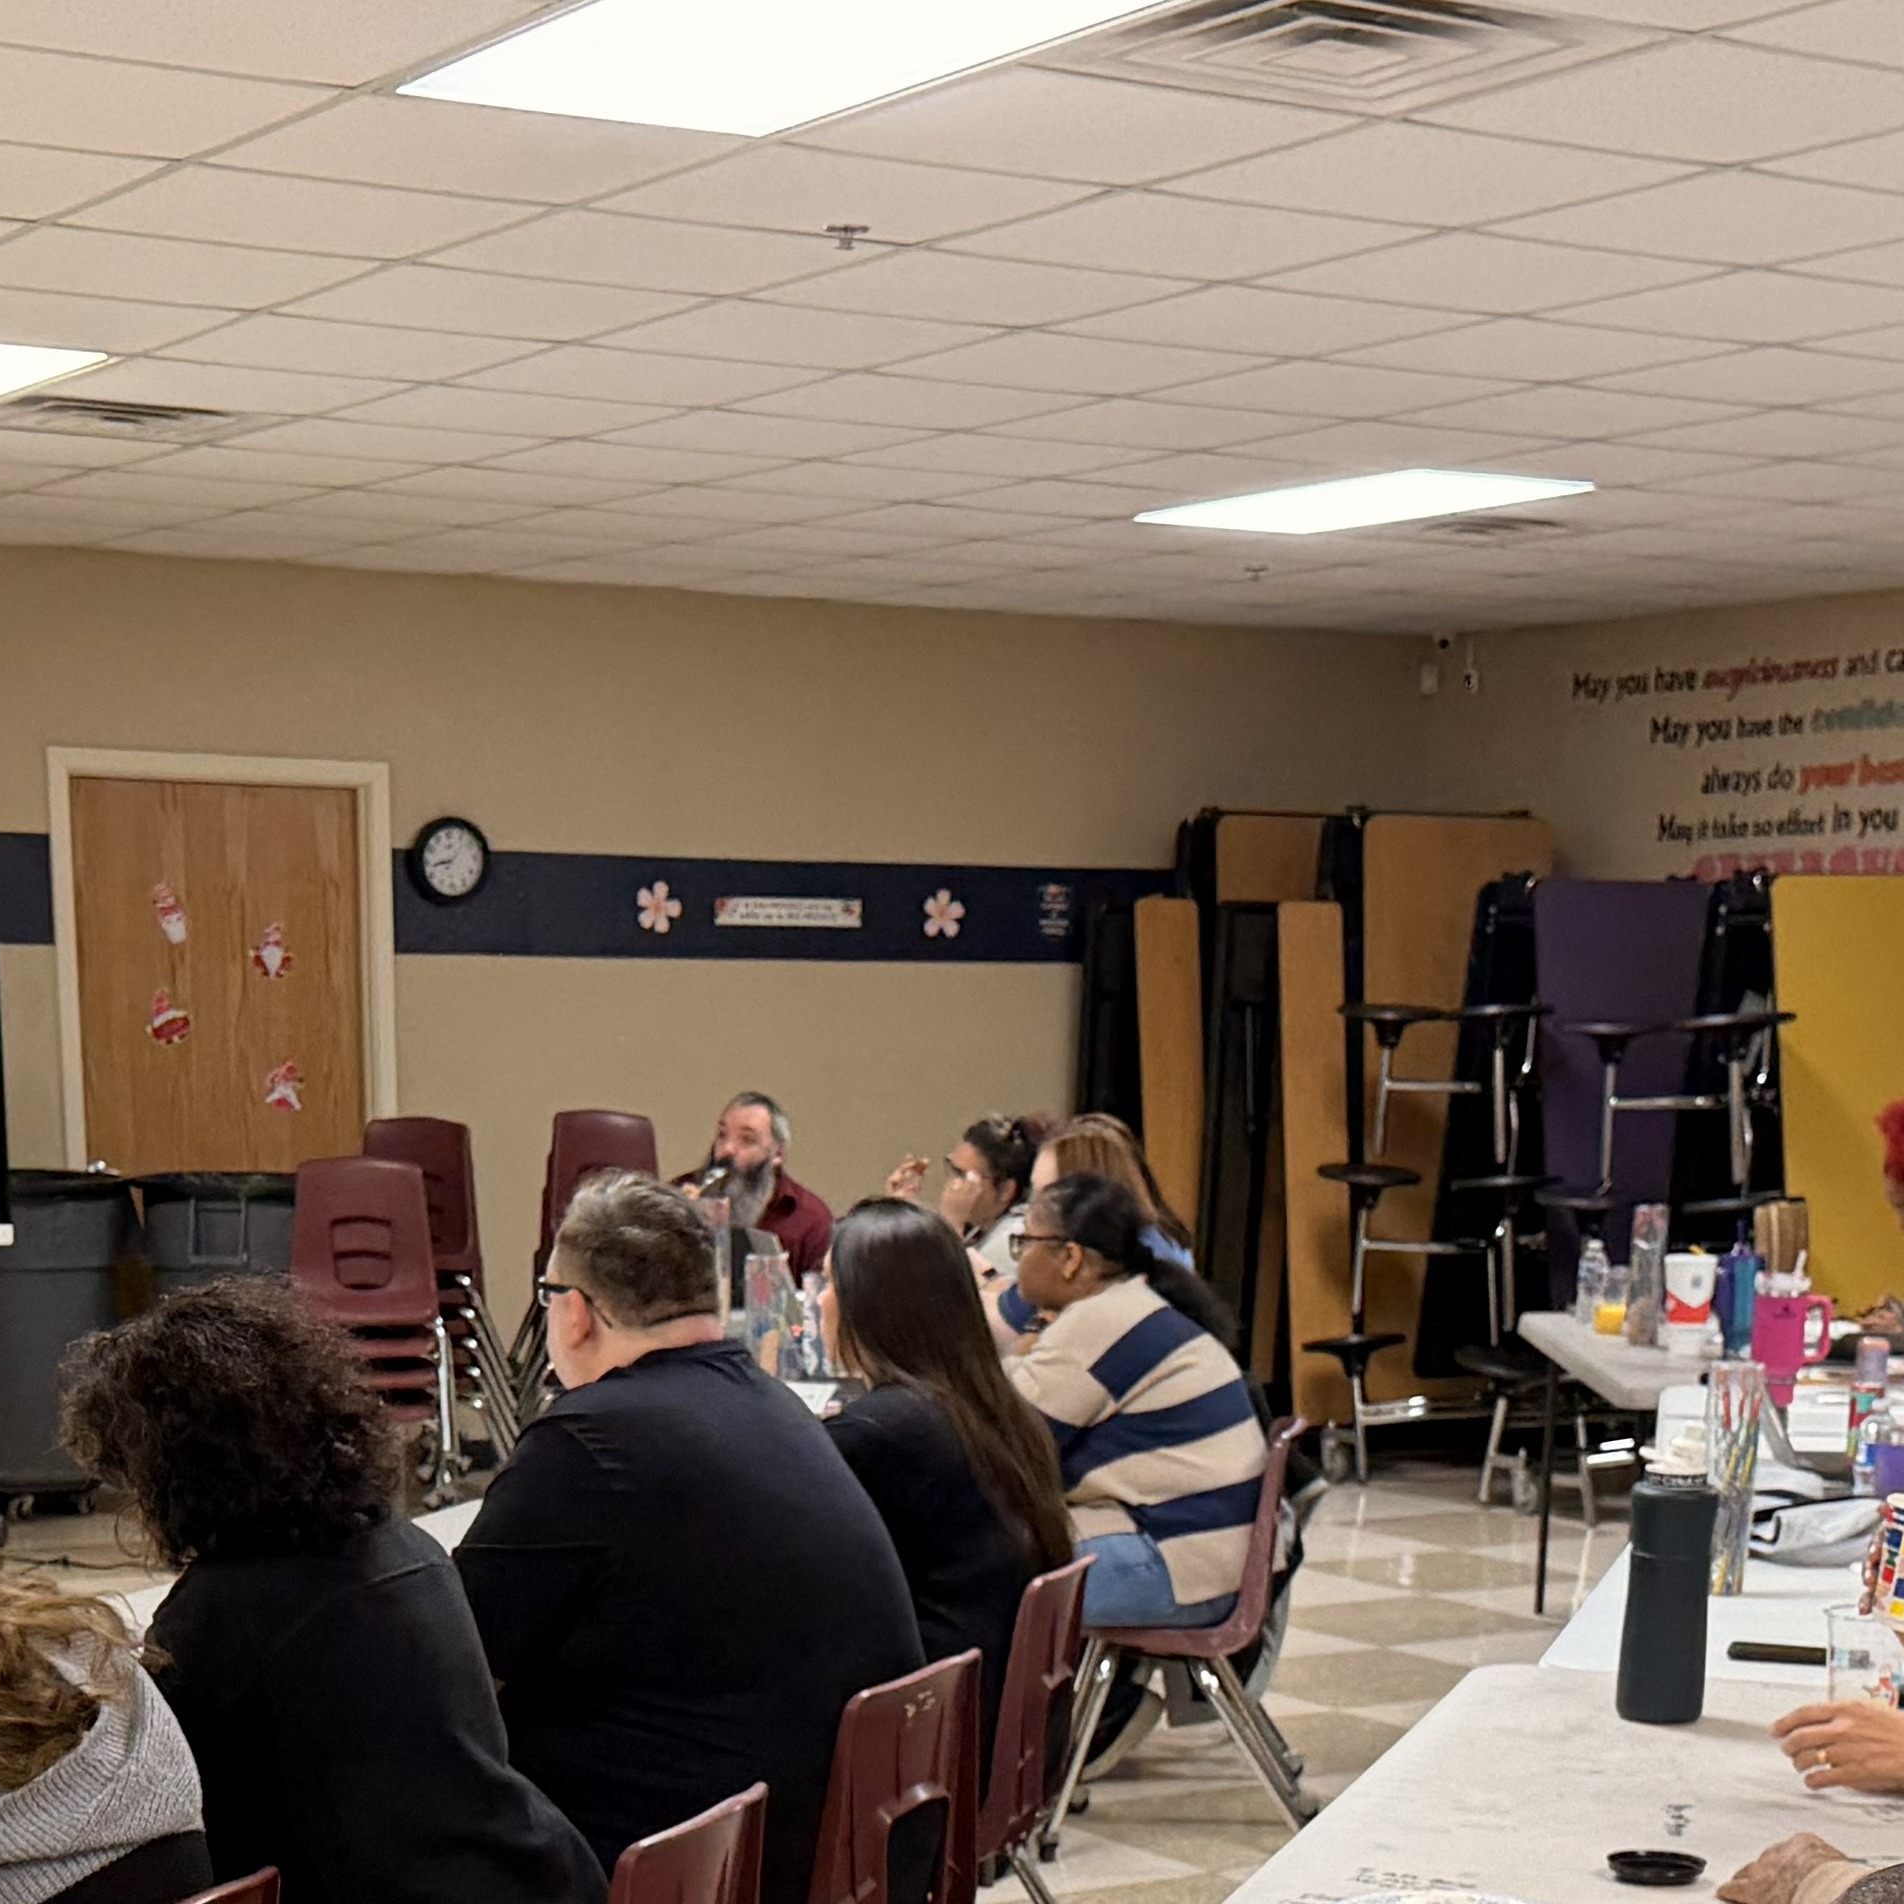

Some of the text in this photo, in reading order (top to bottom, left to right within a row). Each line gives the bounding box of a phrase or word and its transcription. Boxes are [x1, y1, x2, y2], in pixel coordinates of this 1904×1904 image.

[1572, 673, 1610, 704] May
[1615, 674, 1649, 702] you
[1654, 666, 1697, 691] have
[1844, 652, 1879, 676] and
[1650, 715, 1689, 748] May
[1695, 719, 1732, 748] you
[1736, 714, 1773, 739] have
[1779, 711, 1804, 735] the
[1701, 764, 1762, 796] always
[1767, 761, 1796, 791] do
[1657, 811, 1694, 845] May
[1697, 817, 1709, 840] it
[1712, 811, 1749, 839] take
[1832, 801, 1852, 834] in
[1858, 808, 1899, 839] you
